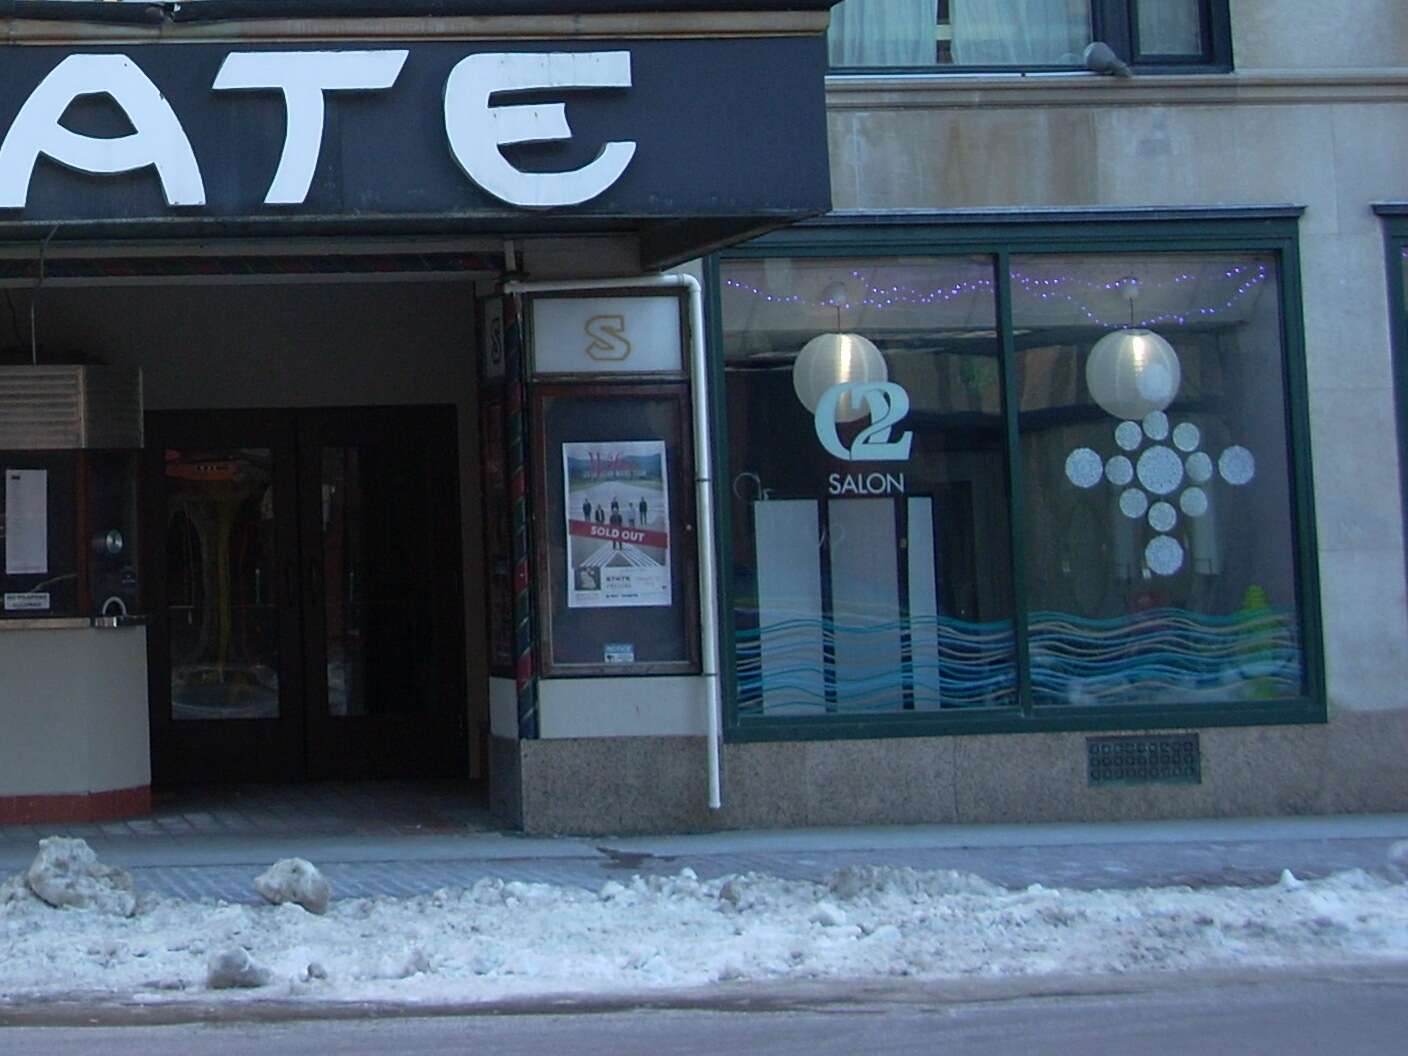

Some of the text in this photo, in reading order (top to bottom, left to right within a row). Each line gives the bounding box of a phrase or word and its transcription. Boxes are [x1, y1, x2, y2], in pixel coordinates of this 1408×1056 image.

[585, 315, 631, 361] S
[828, 472, 905, 495] SALON
[590, 525, 646, 542] SOLD OUT
